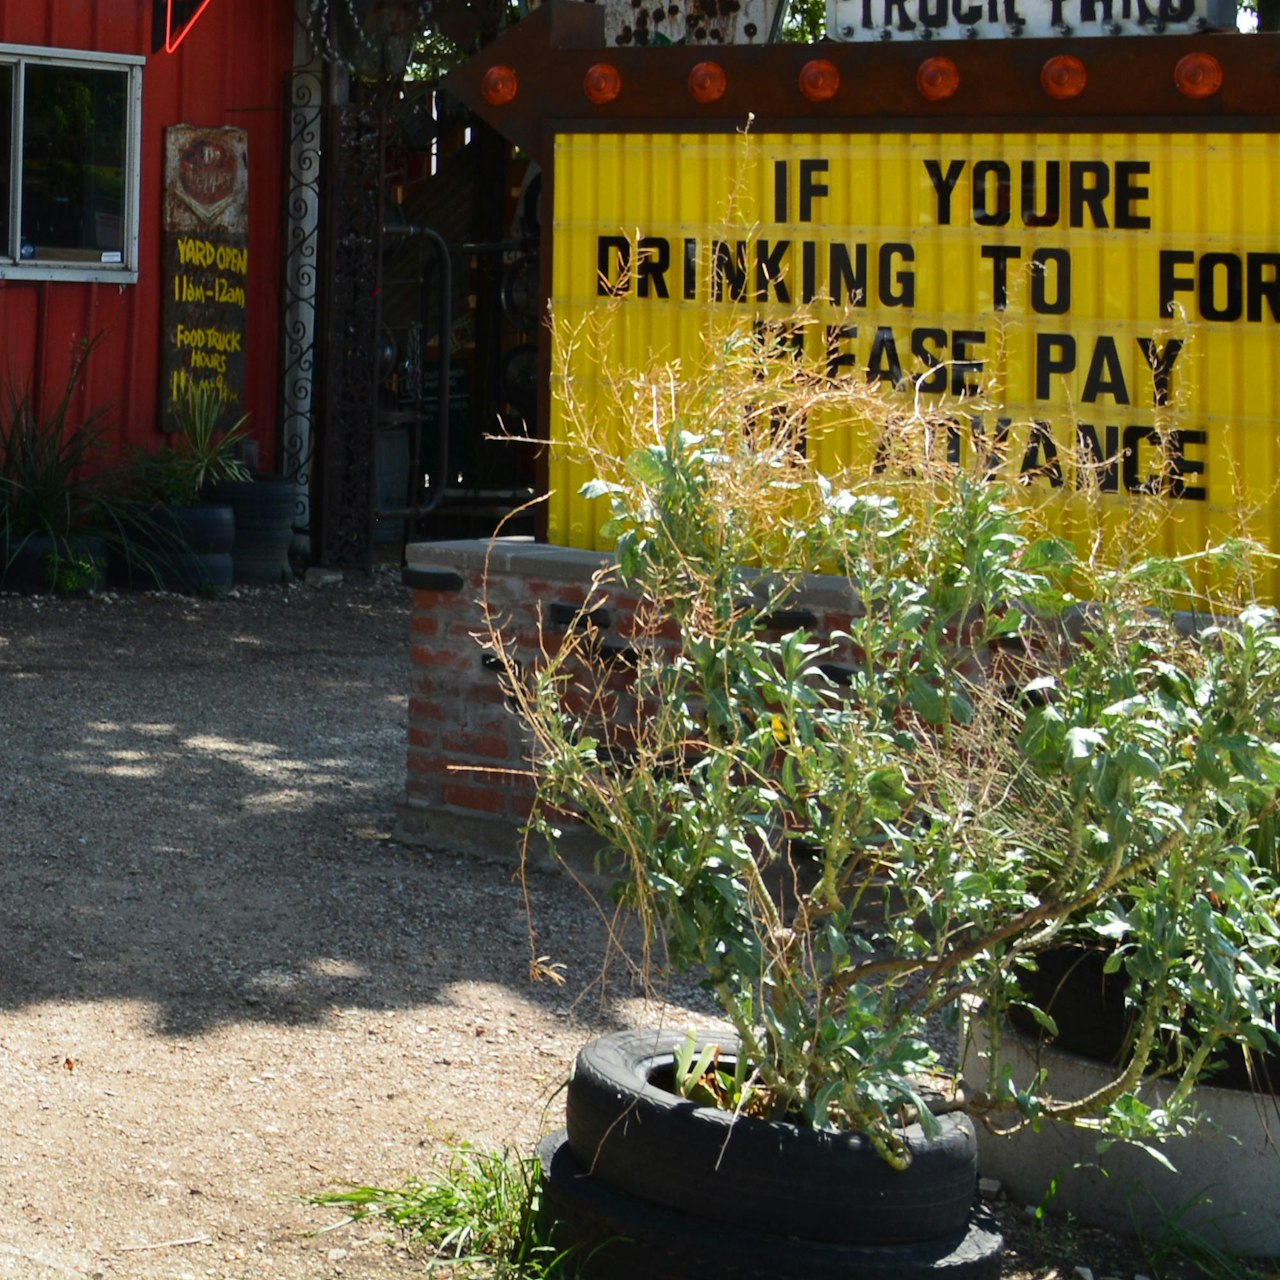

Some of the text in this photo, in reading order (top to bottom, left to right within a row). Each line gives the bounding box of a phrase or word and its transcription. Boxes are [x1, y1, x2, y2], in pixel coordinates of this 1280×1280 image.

[775, 159, 1151, 229] IF YOURE
[178, 235, 248, 276] YARD OPEN
[597, 236, 915, 308] DRINKING
[981, 245, 1071, 315] TO
[177, 323, 241, 352] FOOD TRUCK
[191, 349, 227, 373] HOURS
[1036, 333, 1184, 406] PAY
